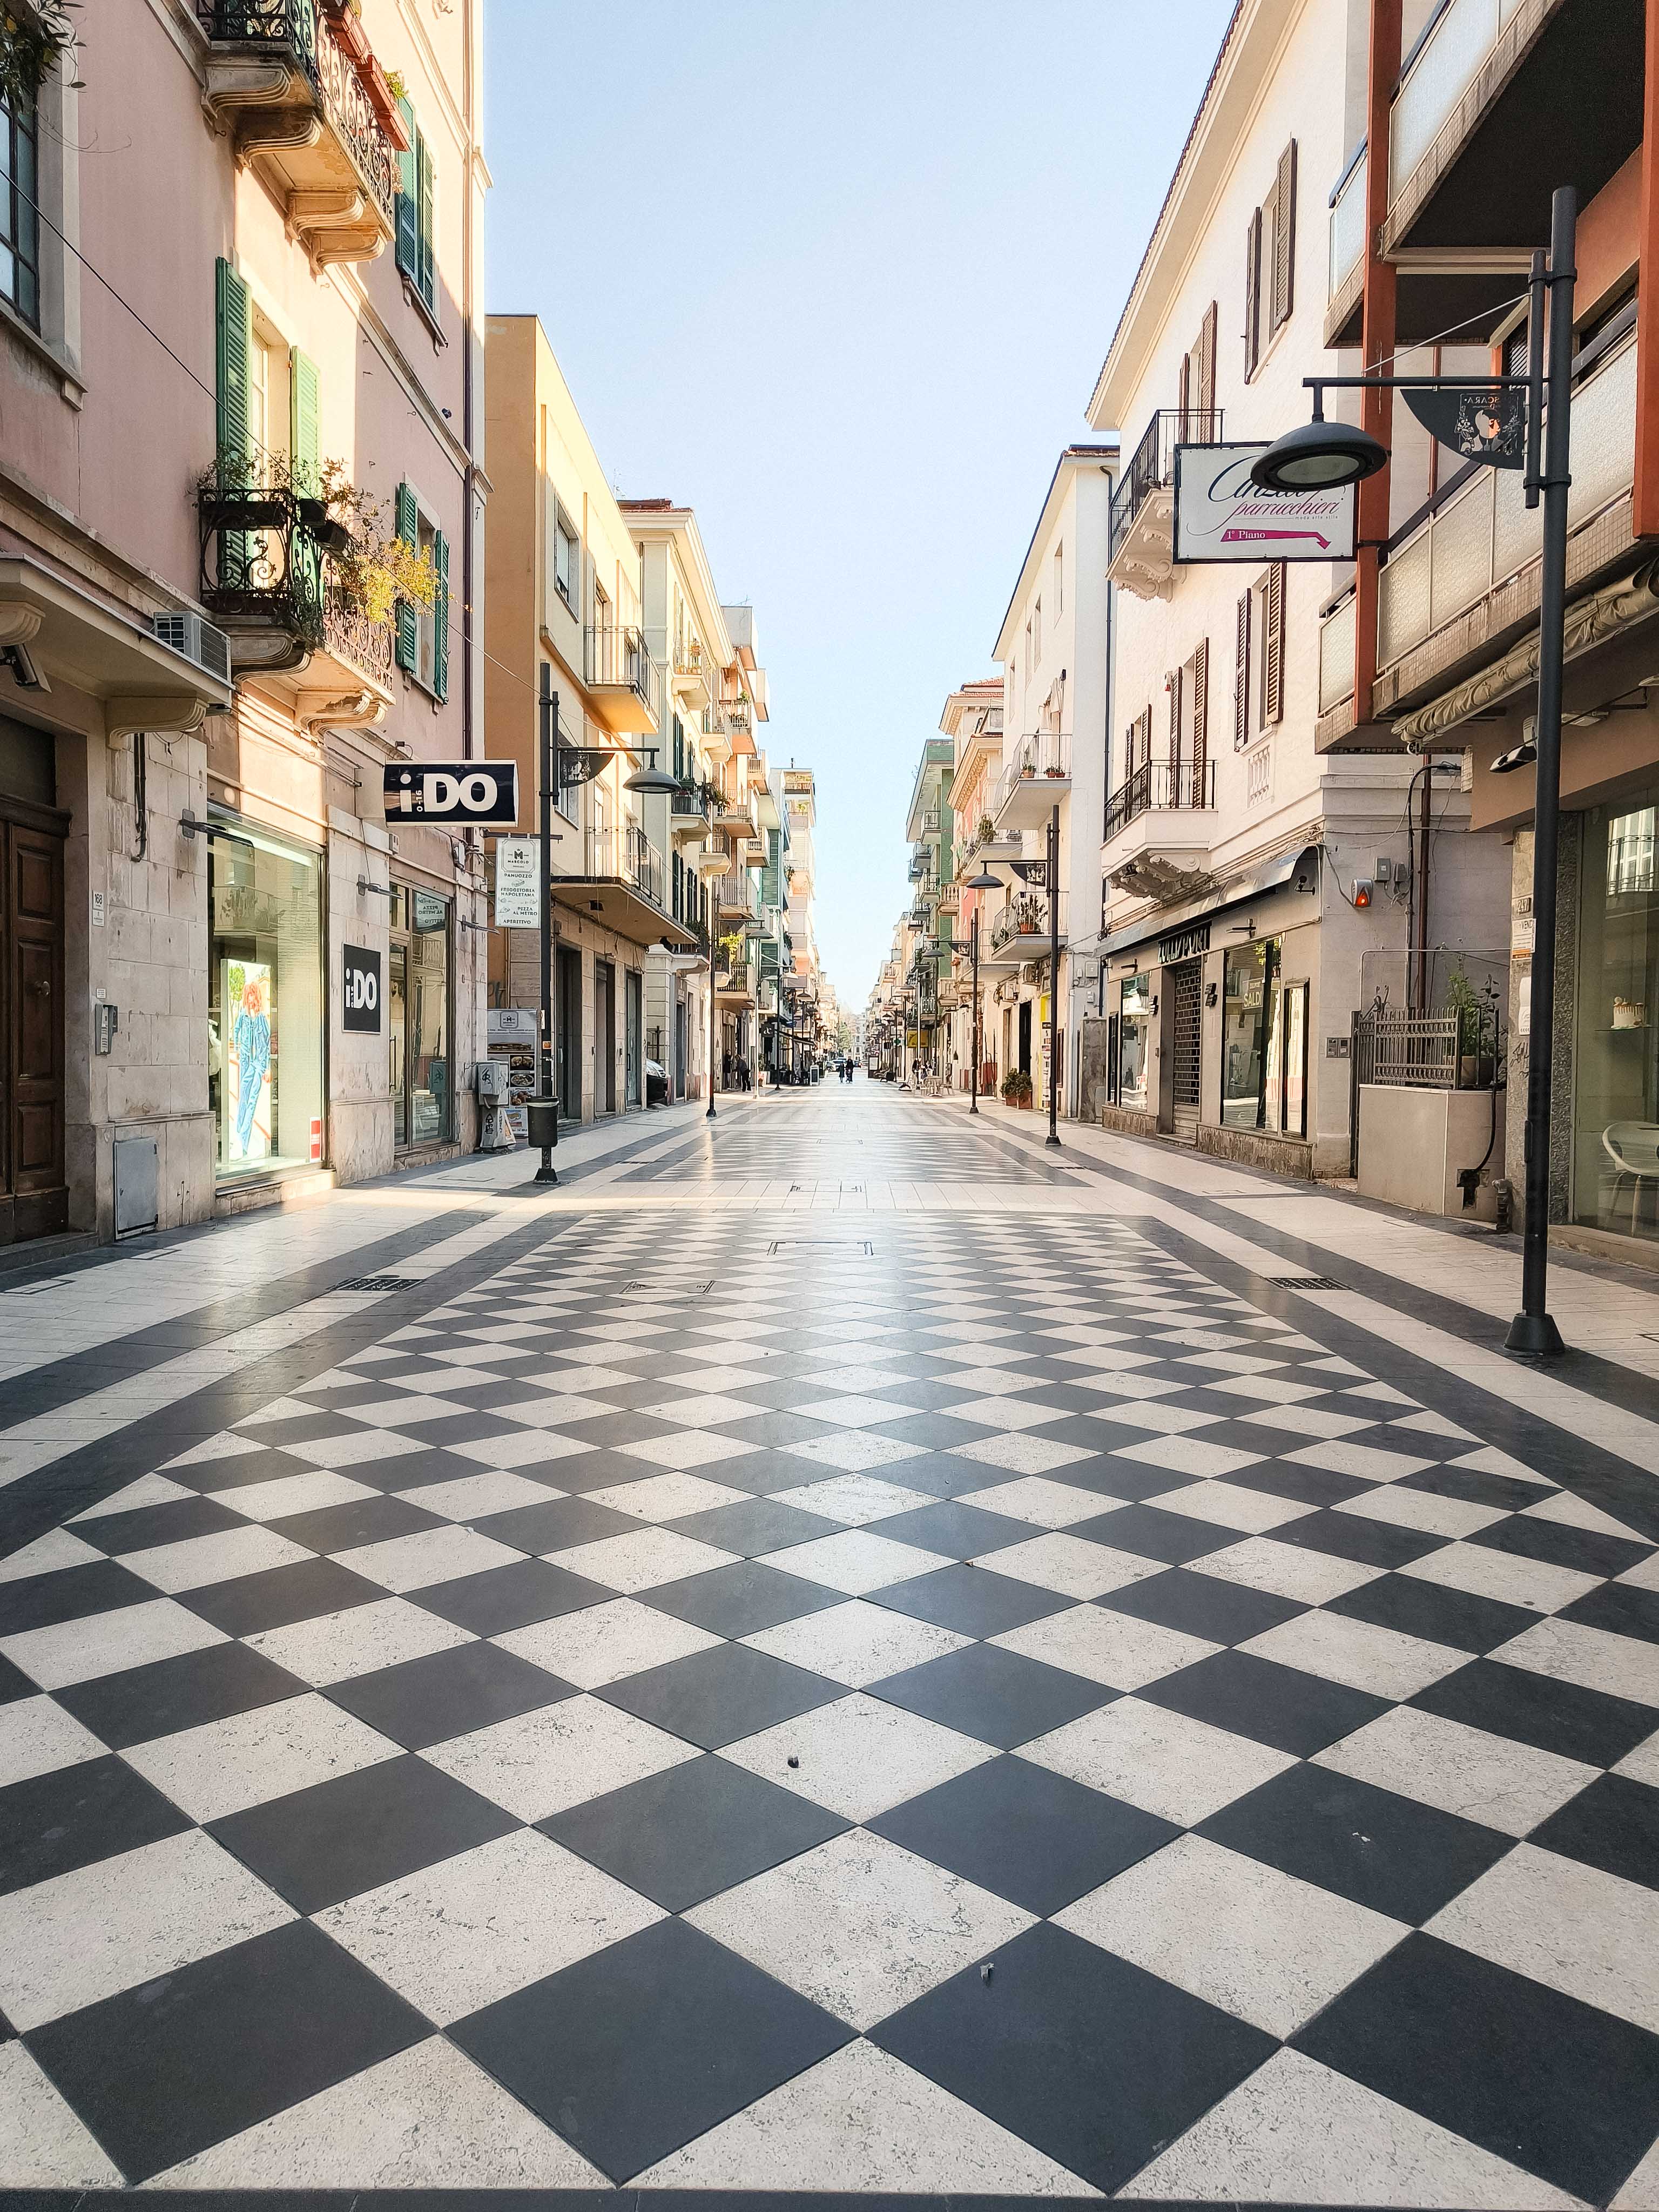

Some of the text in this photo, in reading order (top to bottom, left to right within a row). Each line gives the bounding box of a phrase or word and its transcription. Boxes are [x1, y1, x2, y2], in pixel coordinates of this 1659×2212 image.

[1239, 530, 1265, 539] Piano
[95, 893, 103, 905] 168
[1243, 991, 1262, 1007] SALDI
